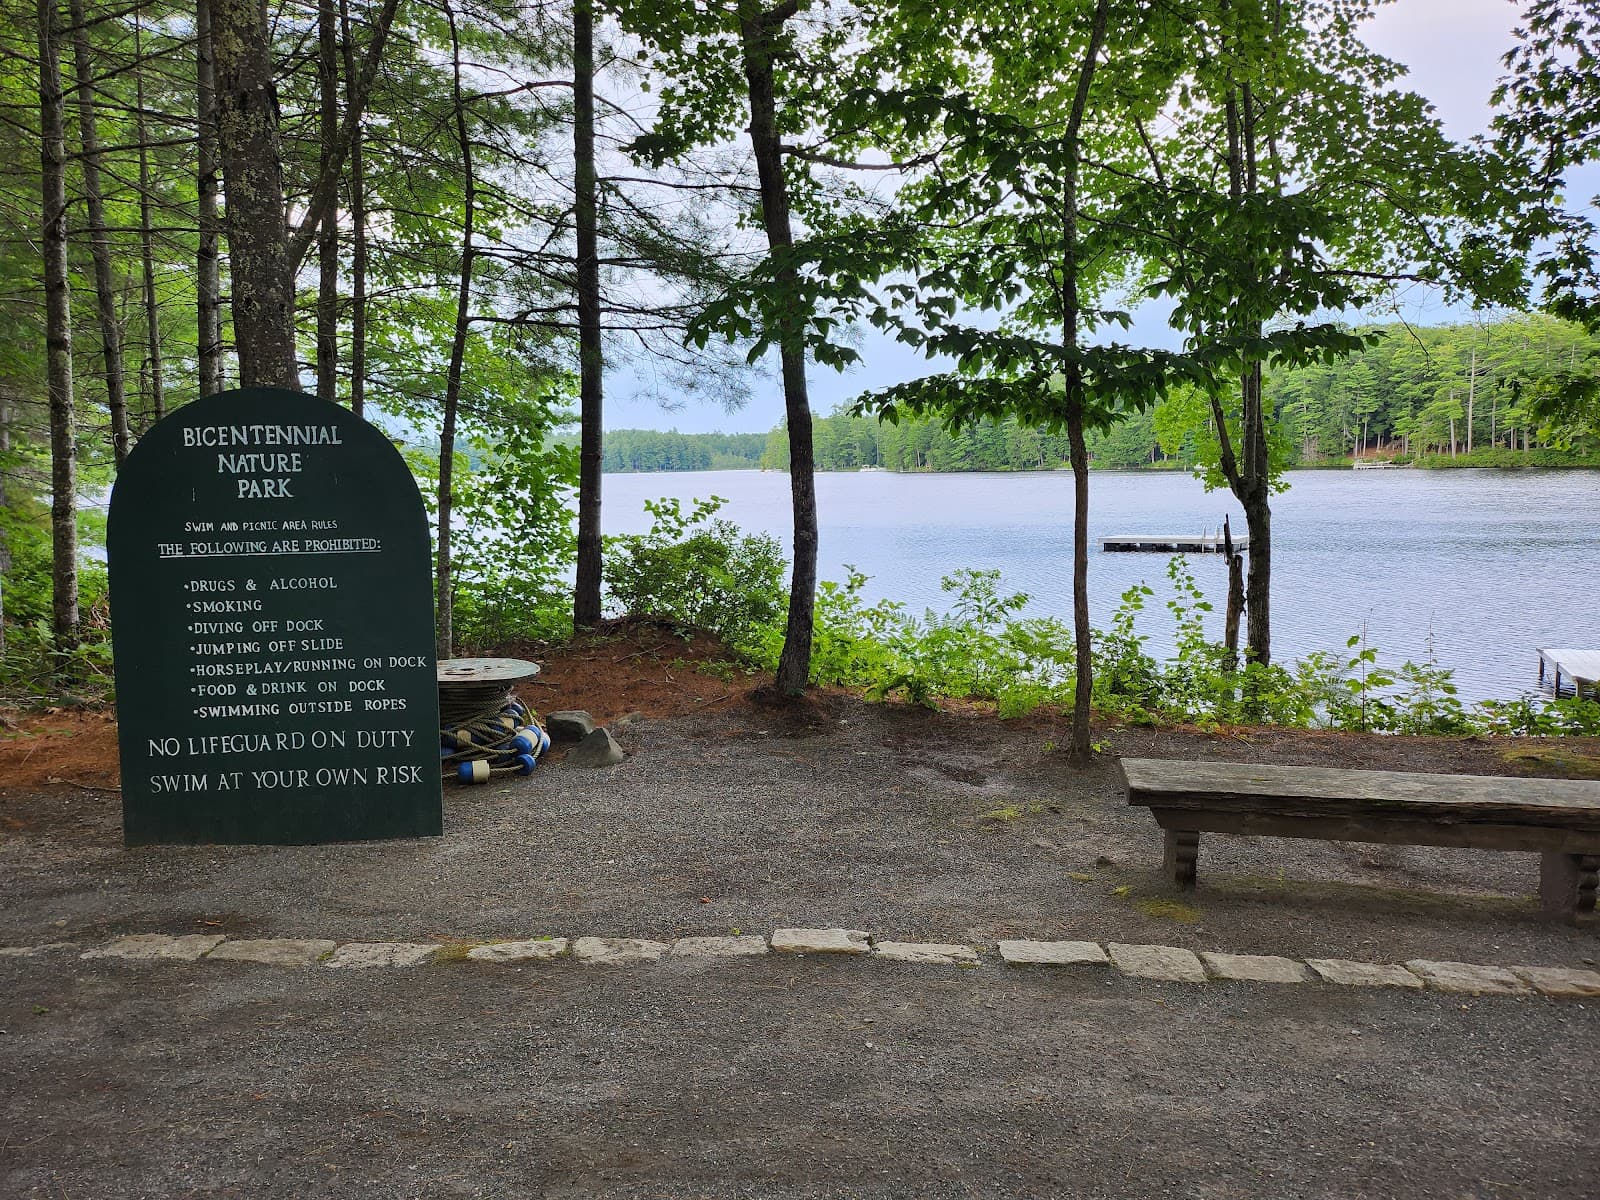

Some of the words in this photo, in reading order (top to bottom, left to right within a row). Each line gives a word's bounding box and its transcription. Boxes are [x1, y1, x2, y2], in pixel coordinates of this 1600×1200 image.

[184, 425, 342, 446] BICENTENNIAL
[218, 453, 301, 473] NATURE
[238, 478, 293, 498] PARK
[185, 522, 213, 532] SWIM
[221, 522, 238, 531] AND
[243, 521, 277, 531] PICNIC
[283, 520, 307, 530] AREA
[312, 520, 337, 529] RULES
[158, 544, 183, 555] THE
[190, 541, 268, 554] FOLLOWING
[272, 540, 299, 552] ARE
[305, 538, 381, 551] PROHIBITED:
[246, 579, 256, 591] &
[270, 577, 337, 590] ALCOHOL
[252, 621, 278, 632] OFF
[287, 620, 323, 631] DOCK
[269, 640, 296, 652] OFF
[301, 639, 343, 650] SLIDE
[364, 658, 381, 668] ON
[389, 657, 426, 667] DOCK
[246, 684, 257, 695] &
[262, 682, 307, 694] DRINK
[318, 681, 336, 692] ON
[349, 680, 385, 692] DOCK
[289, 701, 352, 714] OUTSIDE
[365, 699, 406, 710] ROPES
[148, 738, 180, 756] NO
[188, 732, 304, 755] LIFEGUARD
[312, 730, 345, 748] ON
[357, 730, 414, 748] DUTY
[151, 775, 207, 793] SWIM
[218, 772, 243, 790] AT
[252, 770, 310, 788] YOUR
[316, 768, 367, 786] OWN
[376, 766, 423, 784] RISK
